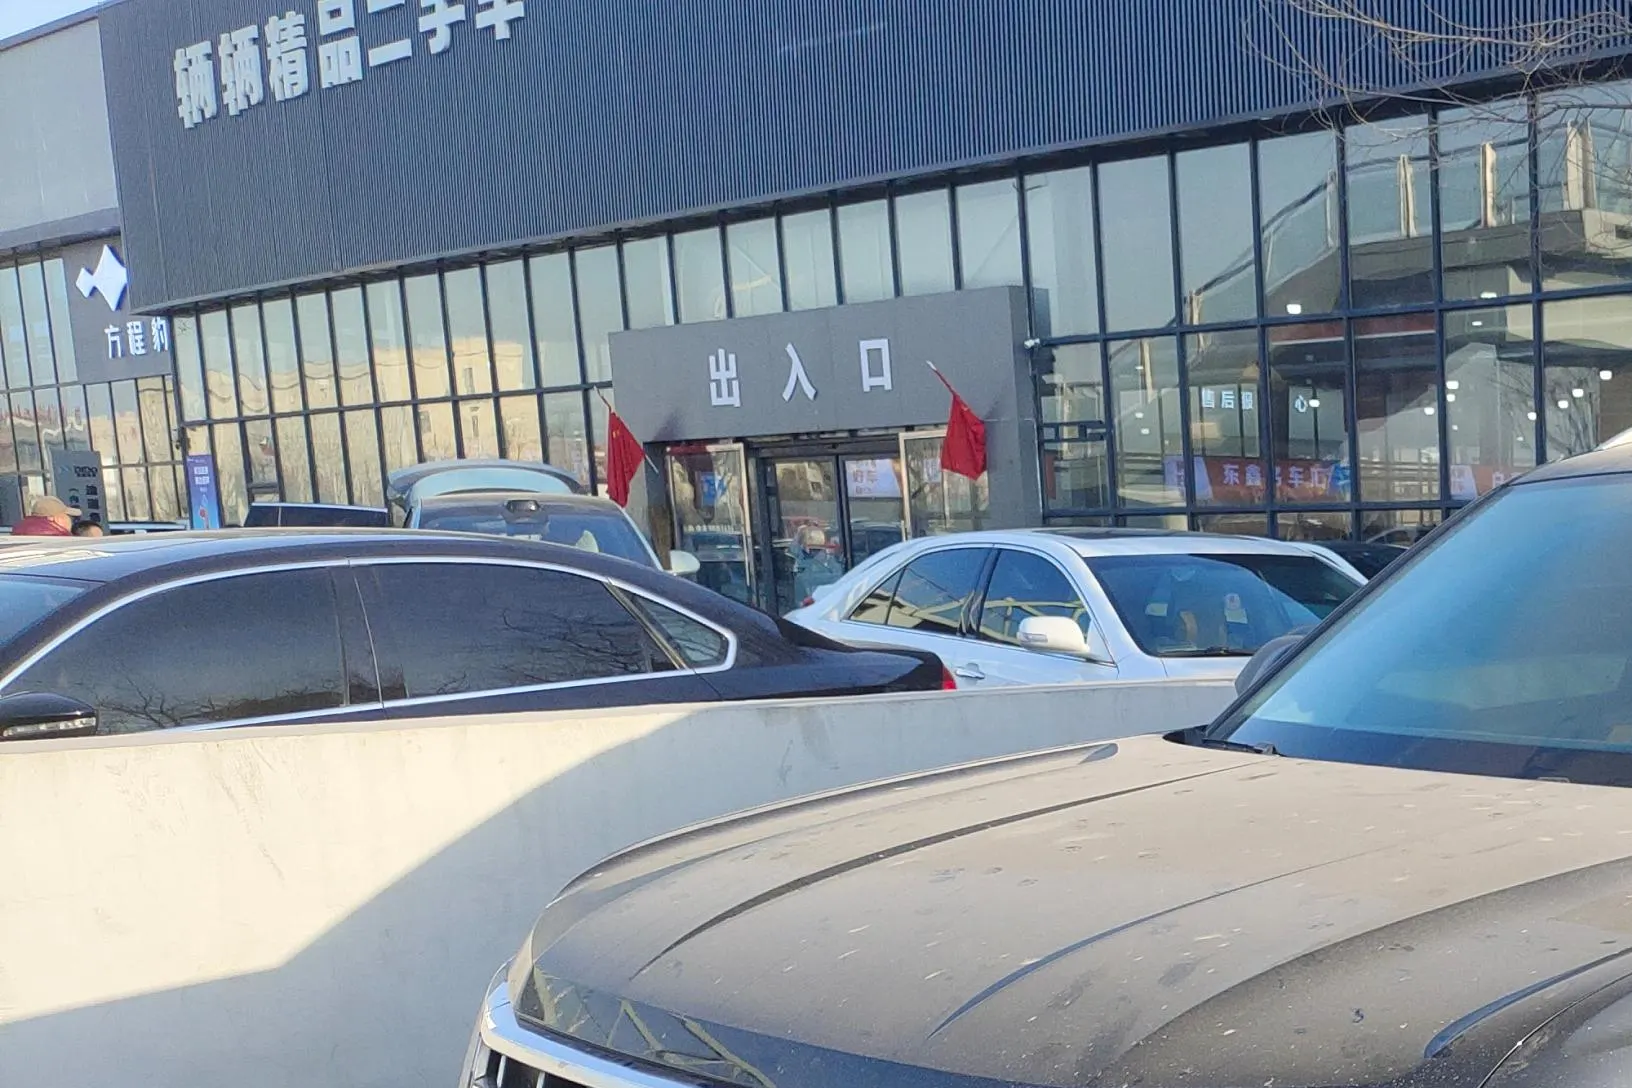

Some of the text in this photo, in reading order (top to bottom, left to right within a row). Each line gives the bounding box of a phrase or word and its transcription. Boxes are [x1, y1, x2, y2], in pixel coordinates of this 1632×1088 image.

[104, 316, 169, 359] 方程豹
[707, 338, 893, 408] 出入口
